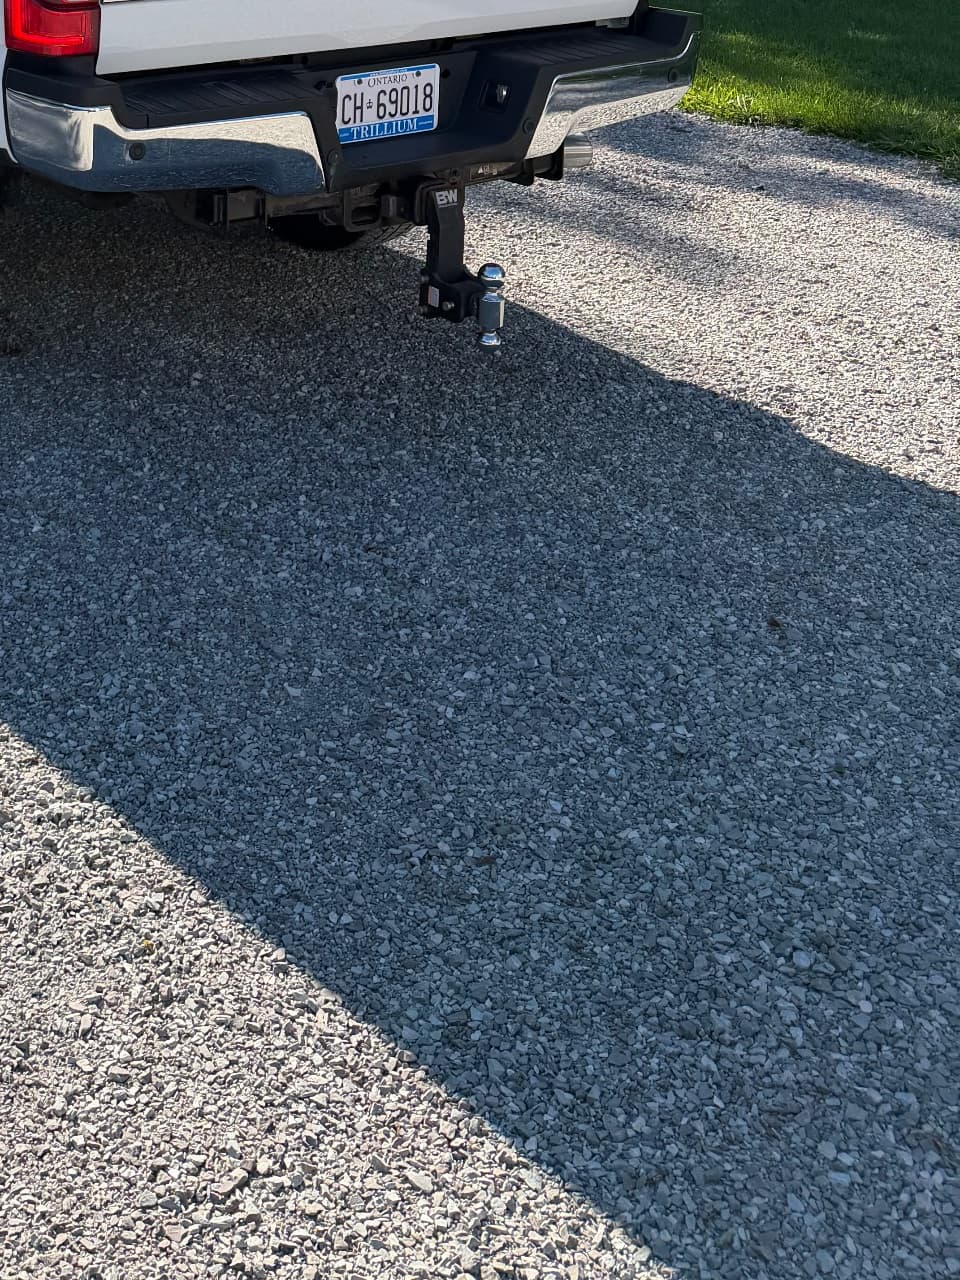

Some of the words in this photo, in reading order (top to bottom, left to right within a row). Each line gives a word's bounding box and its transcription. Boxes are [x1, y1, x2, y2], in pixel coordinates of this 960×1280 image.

[367, 73, 408, 88] ONTARIO
[341, 92, 364, 125] CH
[376, 82, 434, 120] 69018
[350, 118, 418, 140] TRILLIUM
